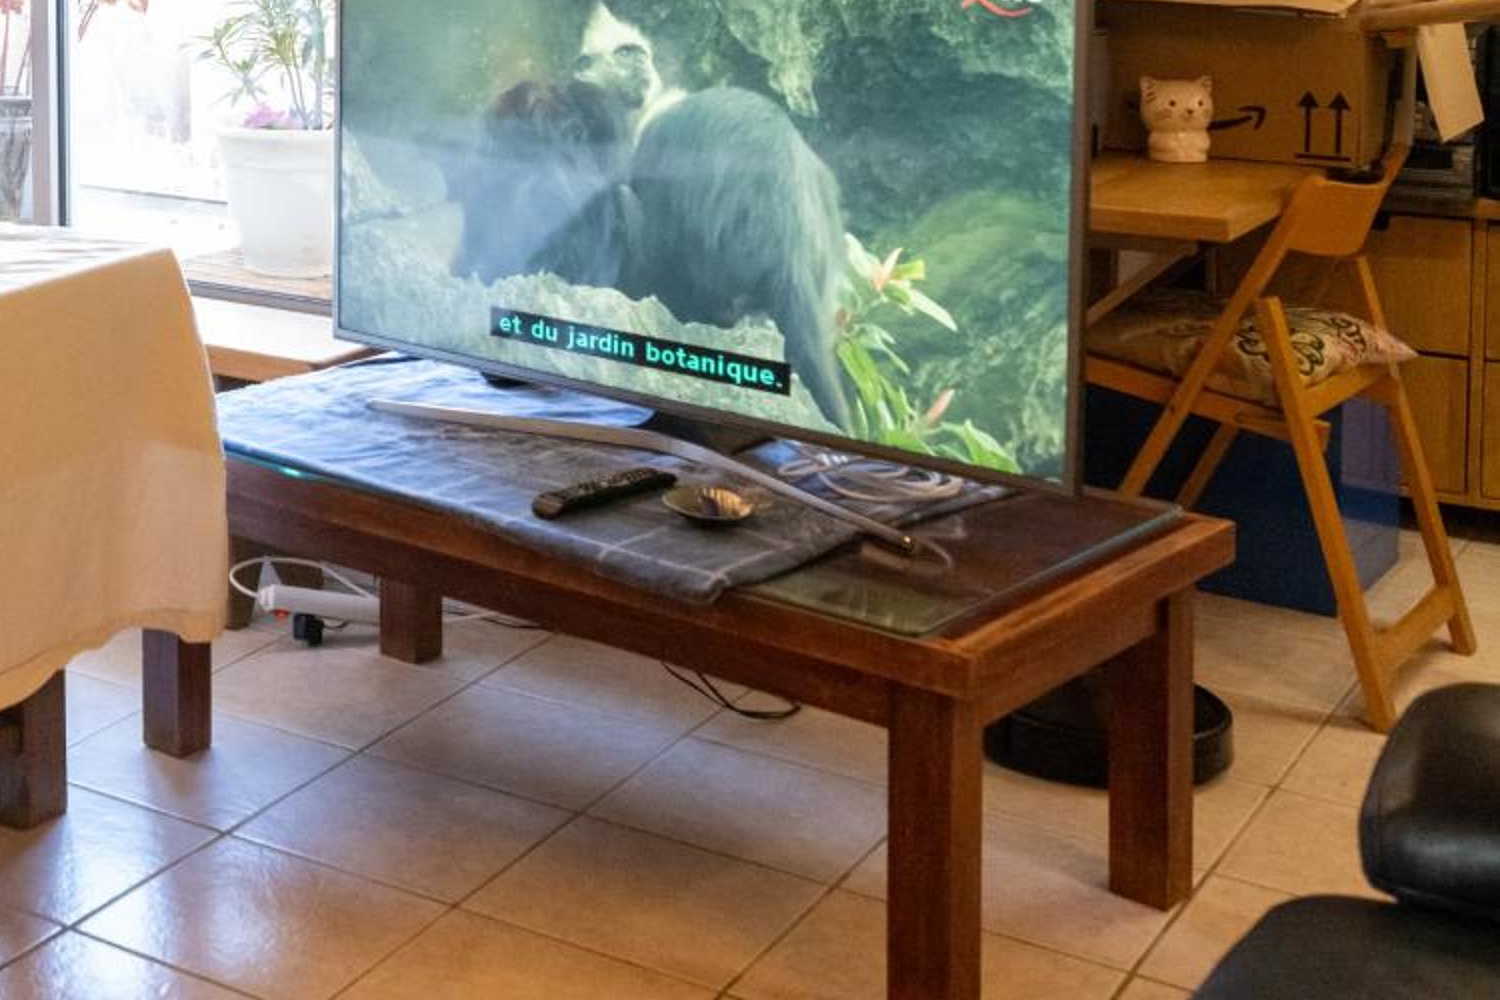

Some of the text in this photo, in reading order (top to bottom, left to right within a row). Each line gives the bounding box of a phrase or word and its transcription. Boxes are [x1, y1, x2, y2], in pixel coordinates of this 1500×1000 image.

[499, 315, 784, 388] et du jardin botanique.
